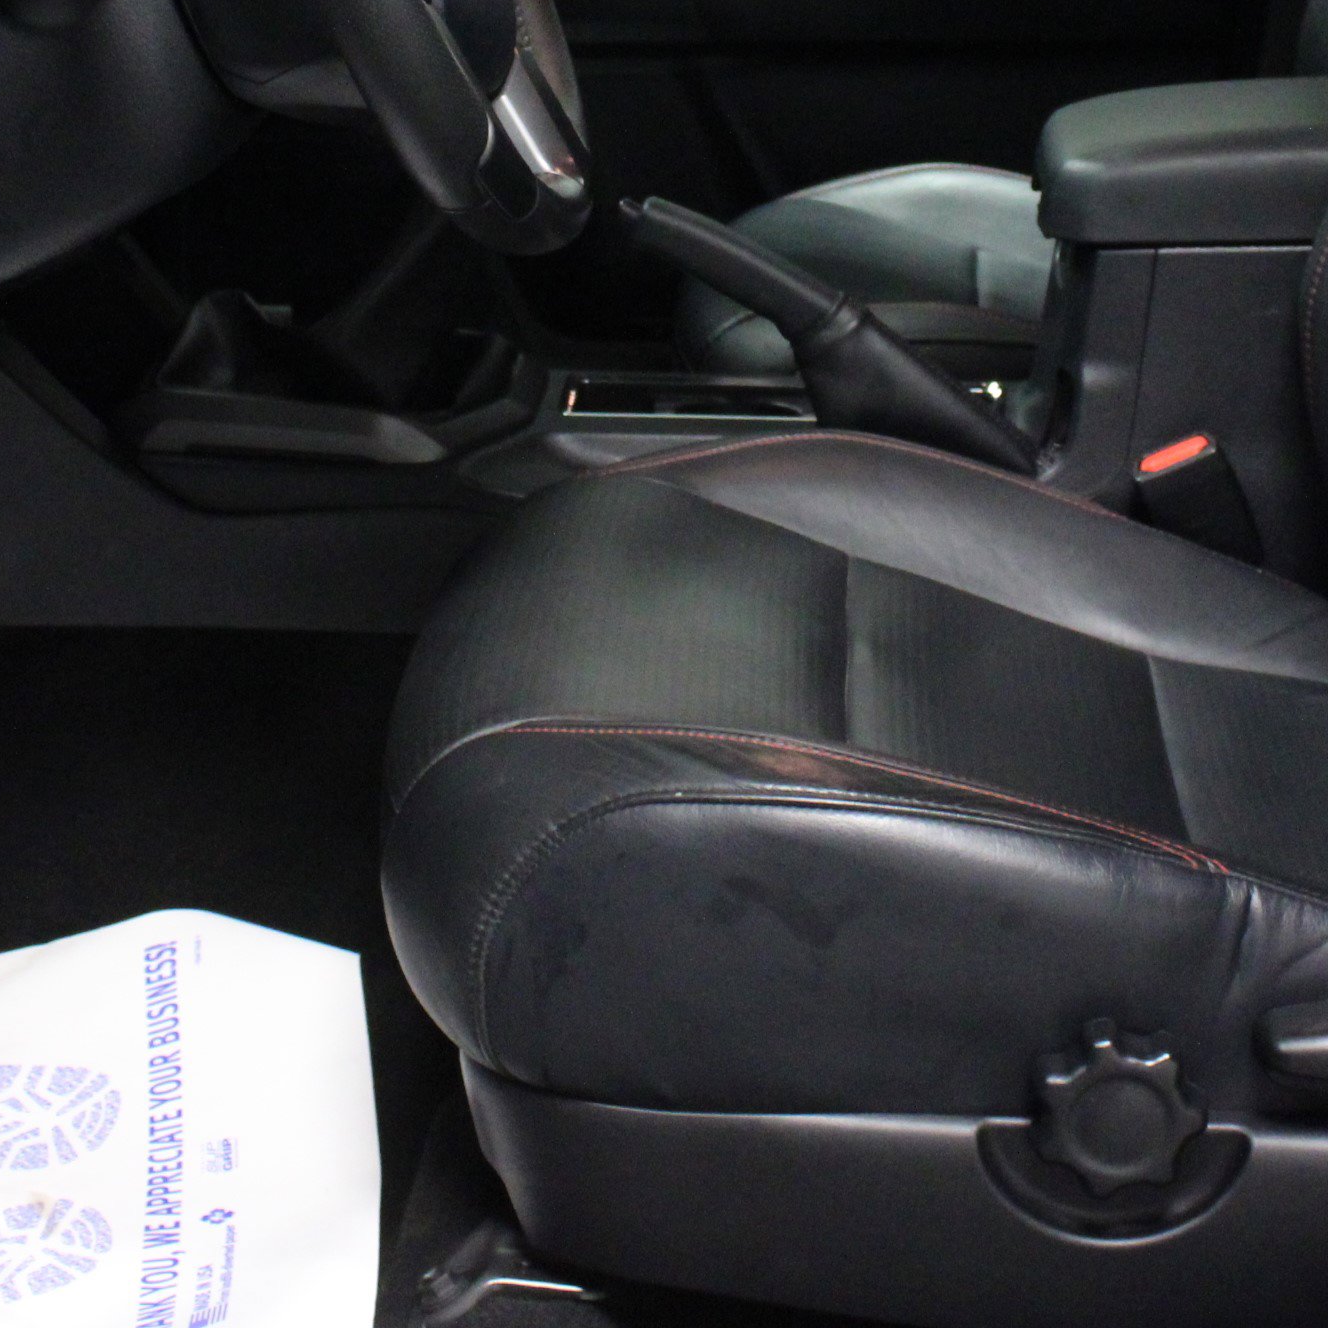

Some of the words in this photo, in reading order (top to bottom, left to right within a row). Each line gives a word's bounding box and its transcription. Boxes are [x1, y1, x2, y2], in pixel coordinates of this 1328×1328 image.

[145, 940, 179, 1048] BUSINESS!
[149, 1049, 181, 1109] YOUR
[146, 1109, 182, 1215] APPRECIATE
[223, 1138, 232, 1171] GRIP
[143, 1221, 180, 1249] WE
[140, 1250, 185, 1297] YOU,
